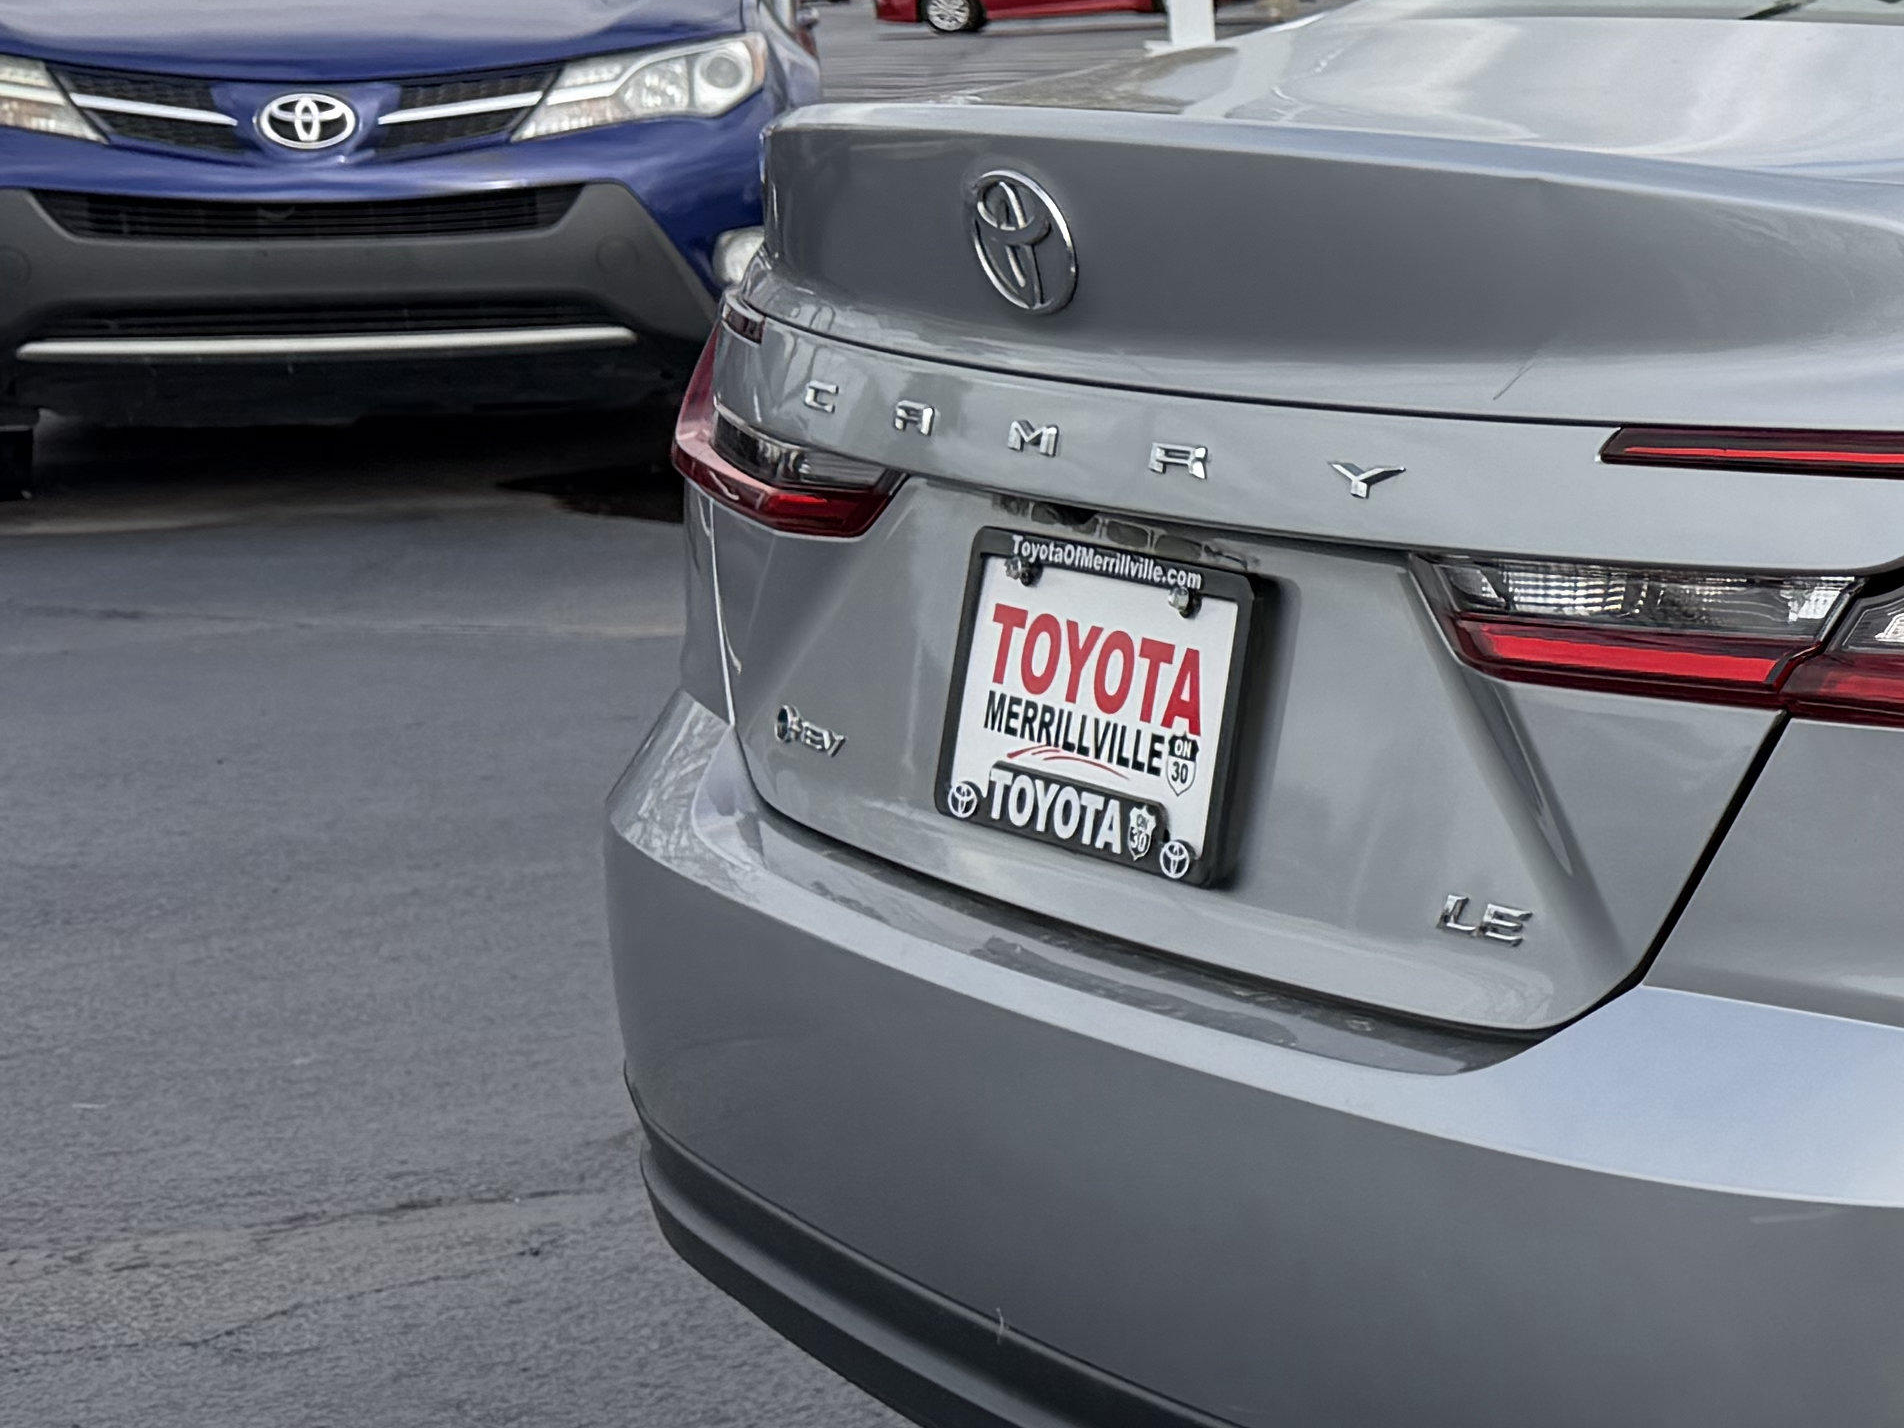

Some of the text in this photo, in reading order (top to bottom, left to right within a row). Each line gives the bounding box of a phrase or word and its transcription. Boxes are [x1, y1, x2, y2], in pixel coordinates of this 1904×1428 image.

[803, 380, 1406, 499] CAMRY
[1011, 535, 1202, 590] ToyotaOfMerrillville.com
[992, 602, 1202, 737] TOYOTA
[983, 690, 1166, 777] MERRILLVILLE
[1174, 739, 1192, 759] ON
[1171, 761, 1188, 785] 30
[989, 770, 1122, 855] TOYOTA
[1129, 825, 1148, 853] 30
[1437, 894, 1534, 948] LE
